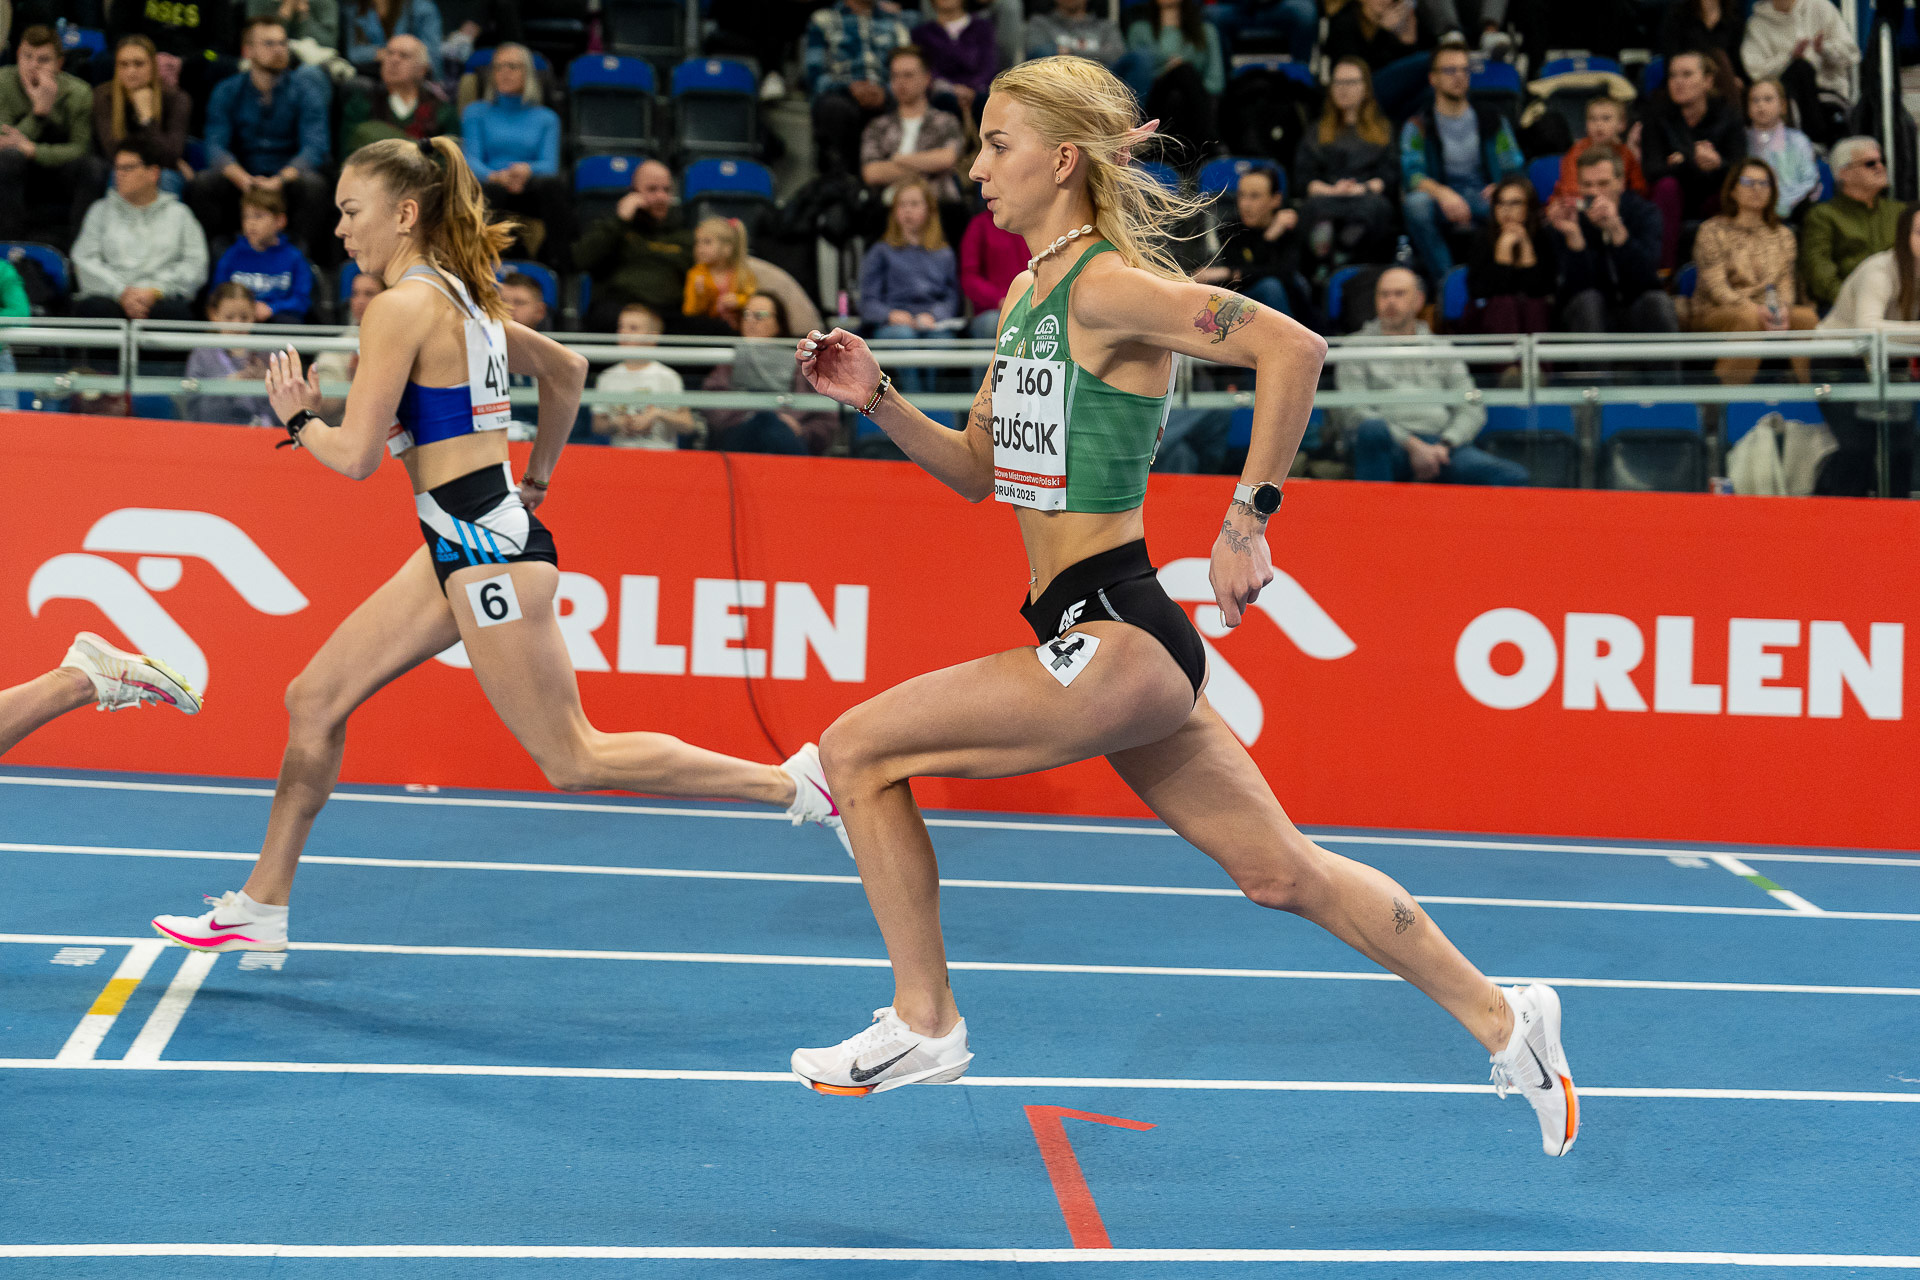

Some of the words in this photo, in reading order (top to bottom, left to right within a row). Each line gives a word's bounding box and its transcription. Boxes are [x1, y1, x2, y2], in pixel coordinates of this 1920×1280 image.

[1000, 326, 1019, 347] 4F
[1040, 322, 1055, 334] AZS
[1035, 342, 1053, 354] AWF
[1016, 366, 1053, 397] 160
[1016, 487, 1036, 502] 2025
[480, 582, 509, 621] 6
[1058, 599, 1087, 634] 4F
[433, 572, 869, 683] RLEN
[1455, 607, 1904, 720] ORLEN
